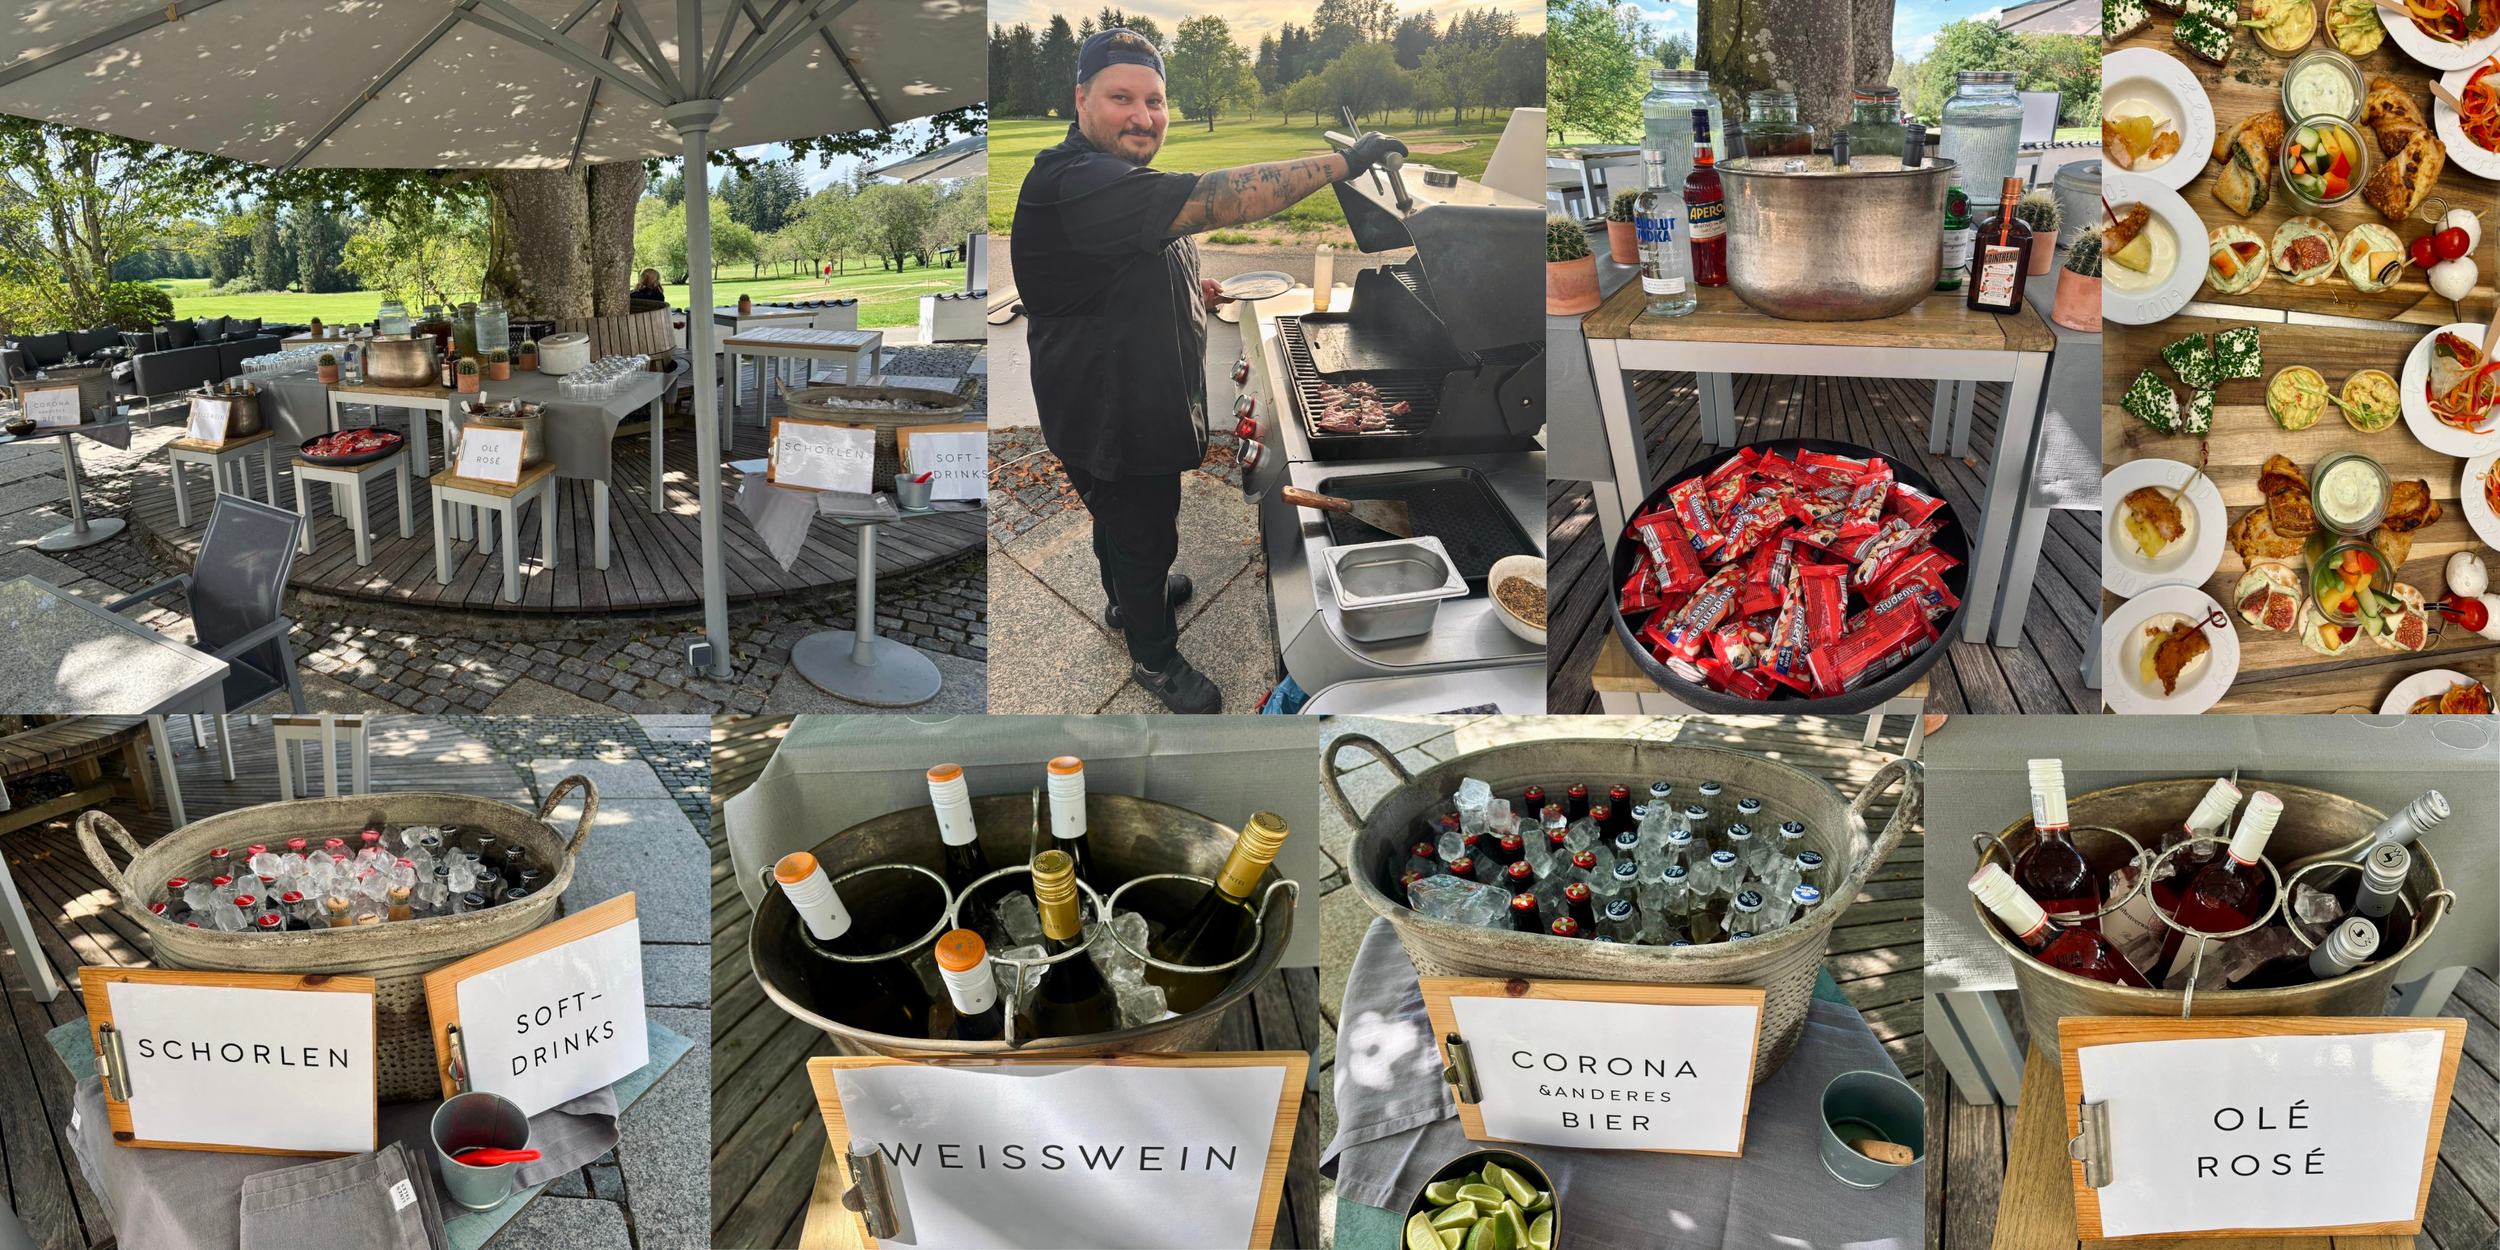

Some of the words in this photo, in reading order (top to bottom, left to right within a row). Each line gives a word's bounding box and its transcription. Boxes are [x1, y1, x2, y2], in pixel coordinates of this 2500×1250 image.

[1690, 204, 1726, 220] APERO
[1637, 230, 1672, 243] VODKA
[1985, 252, 2018, 264] COINTREAU
[33, 401, 70, 409] CORONA
[481, 444, 499, 453] OLÉ
[784, 442, 864, 459] SCHORLEN
[476, 455, 501, 465] ROSÉ
[936, 453, 981, 463] SOFT-
[933, 470, 988, 479] DRINKS
[516, 991, 604, 1035] SOFT-
[138, 1038, 349, 1068] SCHORLEN
[511, 1020, 616, 1077] DRINKS
[1511, 1050, 1699, 1079] CORONA
[1539, 1084, 1672, 1103] &ANDERES
[1562, 1111, 1651, 1132] BIER
[2213, 1099, 2310, 1132] OLÉ
[878, 1142, 1239, 1172] WEISSWEIN
[2197, 1147, 2326, 1179] ROSÉ
